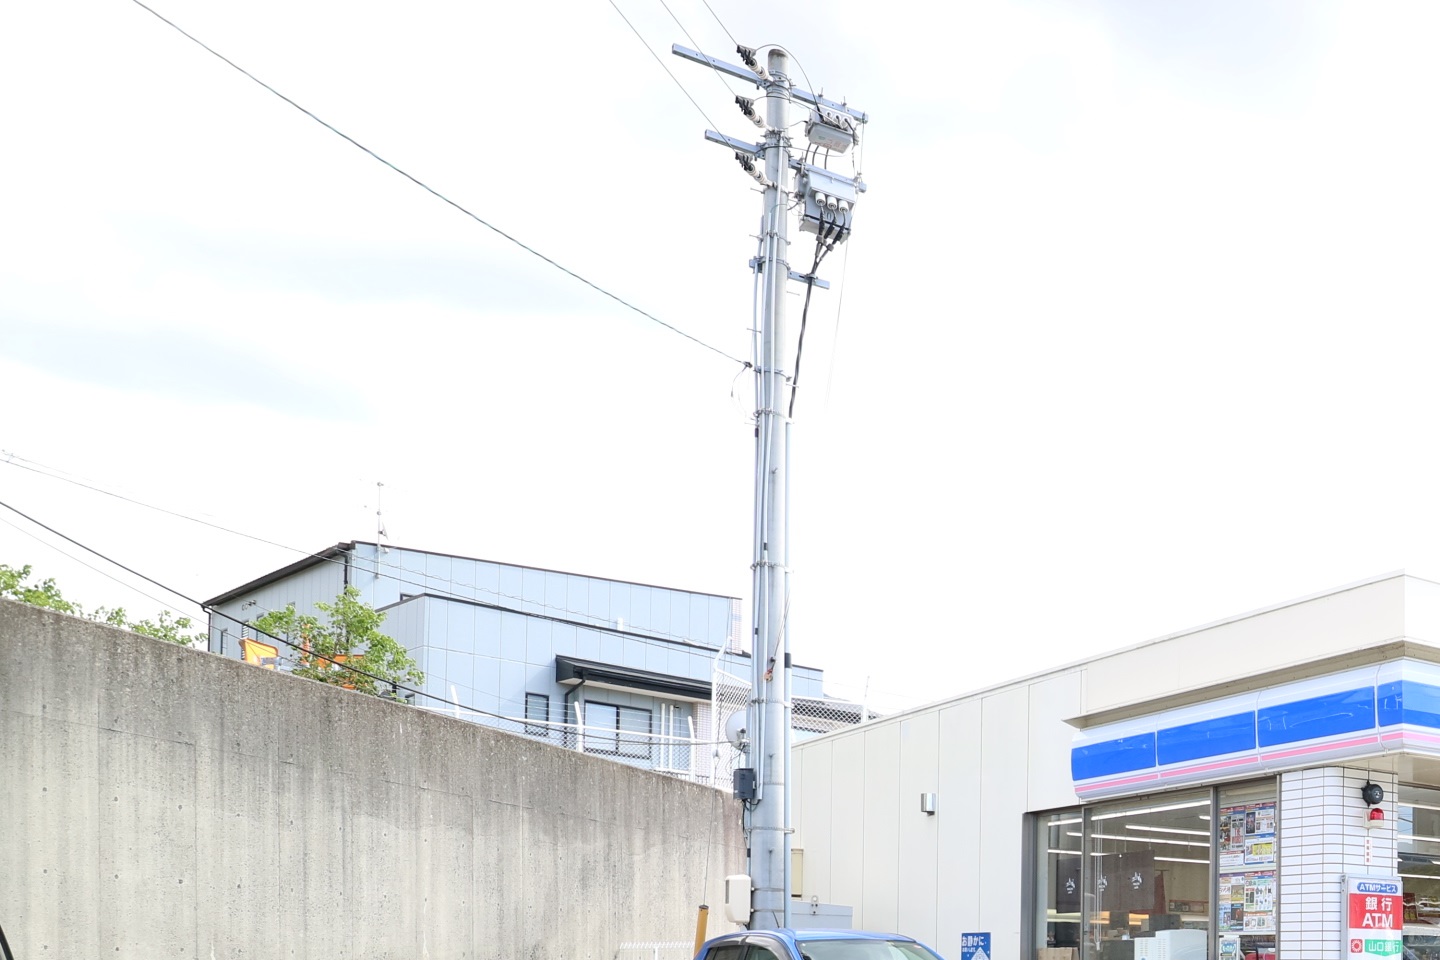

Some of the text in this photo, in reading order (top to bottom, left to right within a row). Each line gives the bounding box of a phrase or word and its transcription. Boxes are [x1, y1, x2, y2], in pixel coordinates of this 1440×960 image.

[1359, 884, 1397, 893] ATMサービス
[1365, 896, 1393, 912] 銀行
[1362, 912, 1393, 928] ATM
[1368, 941, 1399, 952] 山口銀行
